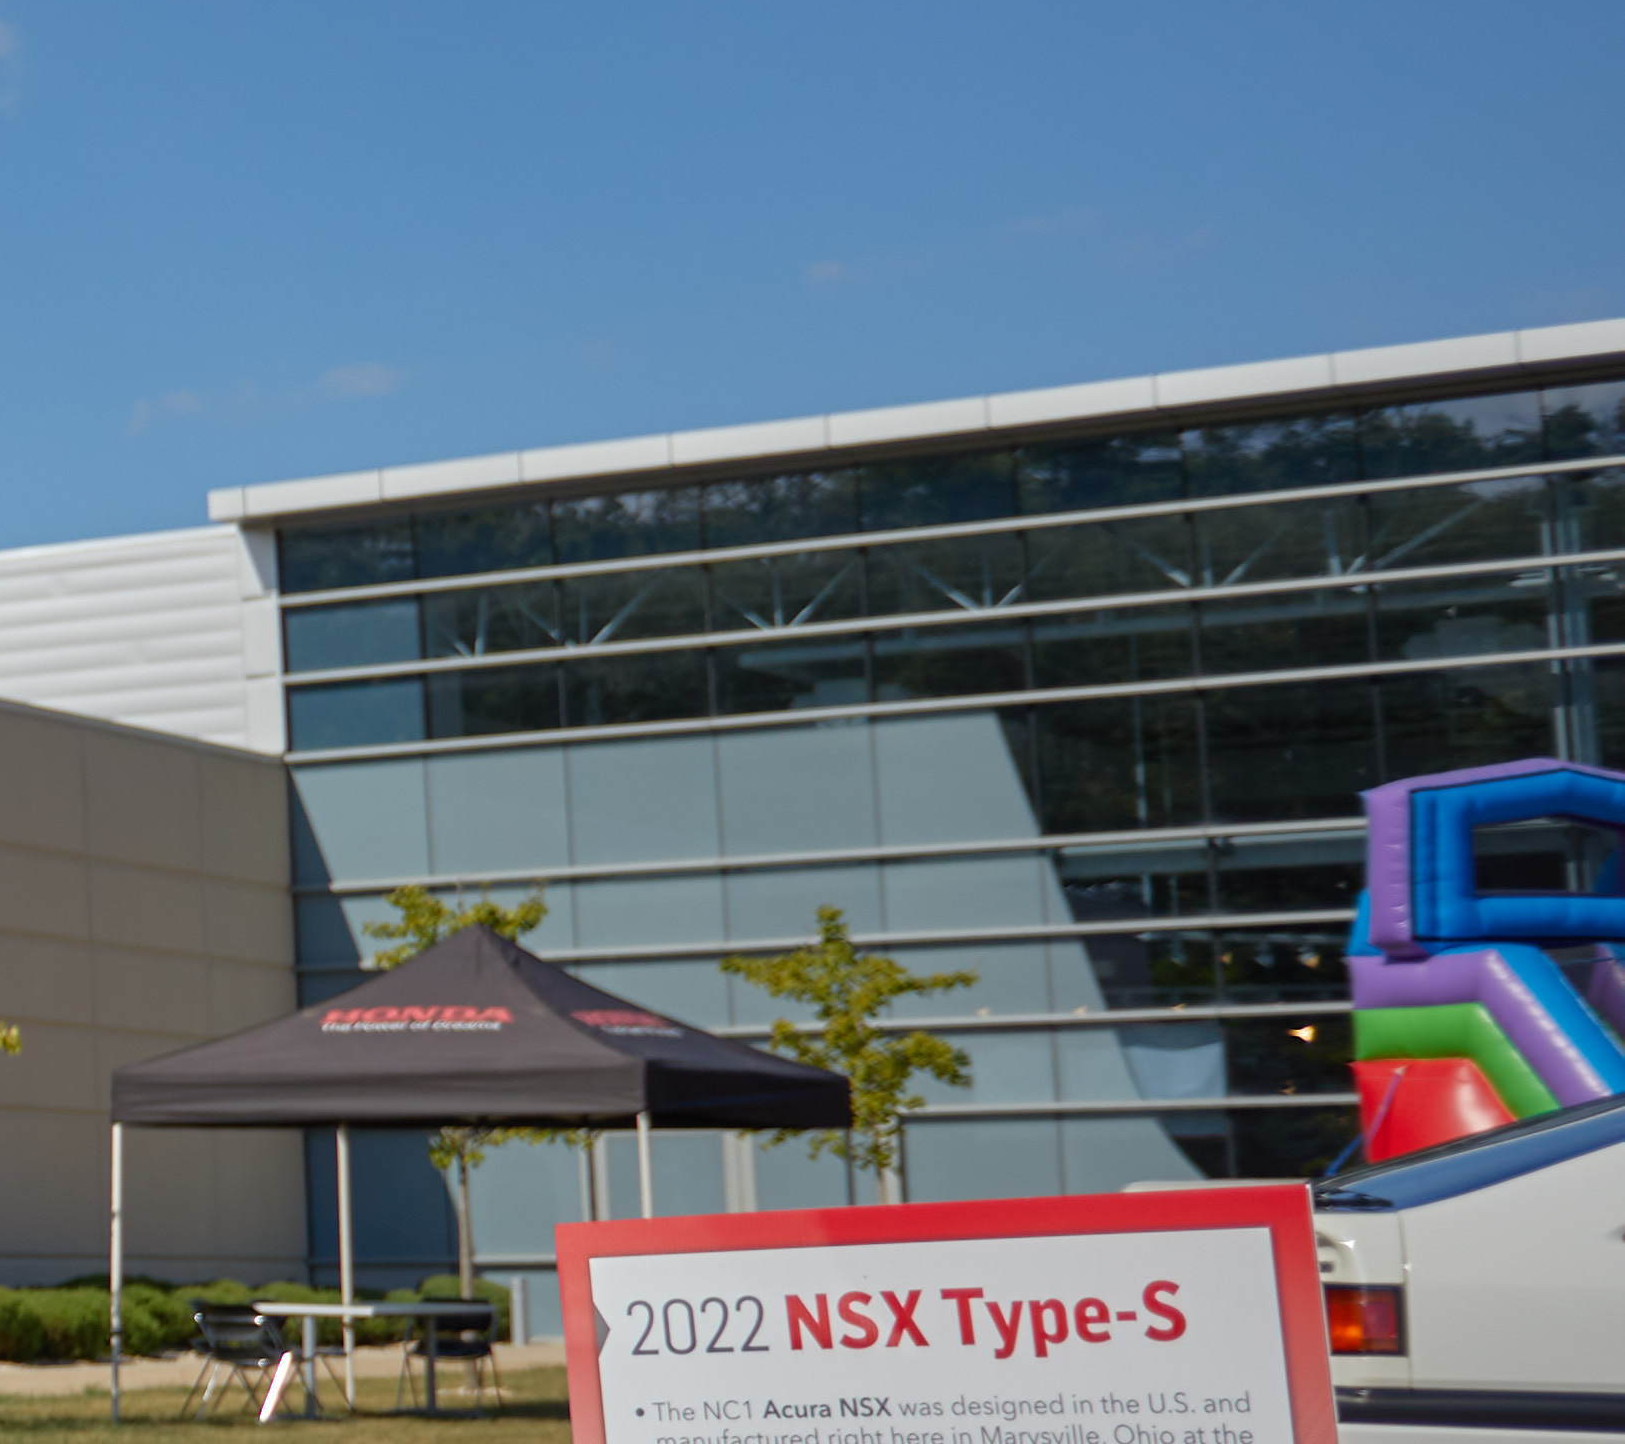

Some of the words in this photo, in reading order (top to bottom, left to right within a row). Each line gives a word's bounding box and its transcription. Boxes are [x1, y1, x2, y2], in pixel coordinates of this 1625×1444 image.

[320, 1006, 513, 1024] HONDA
[626, 1295, 771, 1356] 2022
[784, 1288, 931, 1351] NSX
[939, 1279, 1188, 1360] Type-S
[651, 1401, 695, 1421] The
[702, 1399, 752, 1420] NC1
[762, 1399, 832, 1419] Acura
[838, 1396, 893, 1418] NSX
[897, 1401, 944, 1417] was
[950, 1393, 1065, 1422] designed
[1072, 1394, 1093, 1414] in
[1099, 1392, 1140, 1414] the
[1147, 1391, 1195, 1414] U.S.
[1203, 1391, 1251, 1414] and
